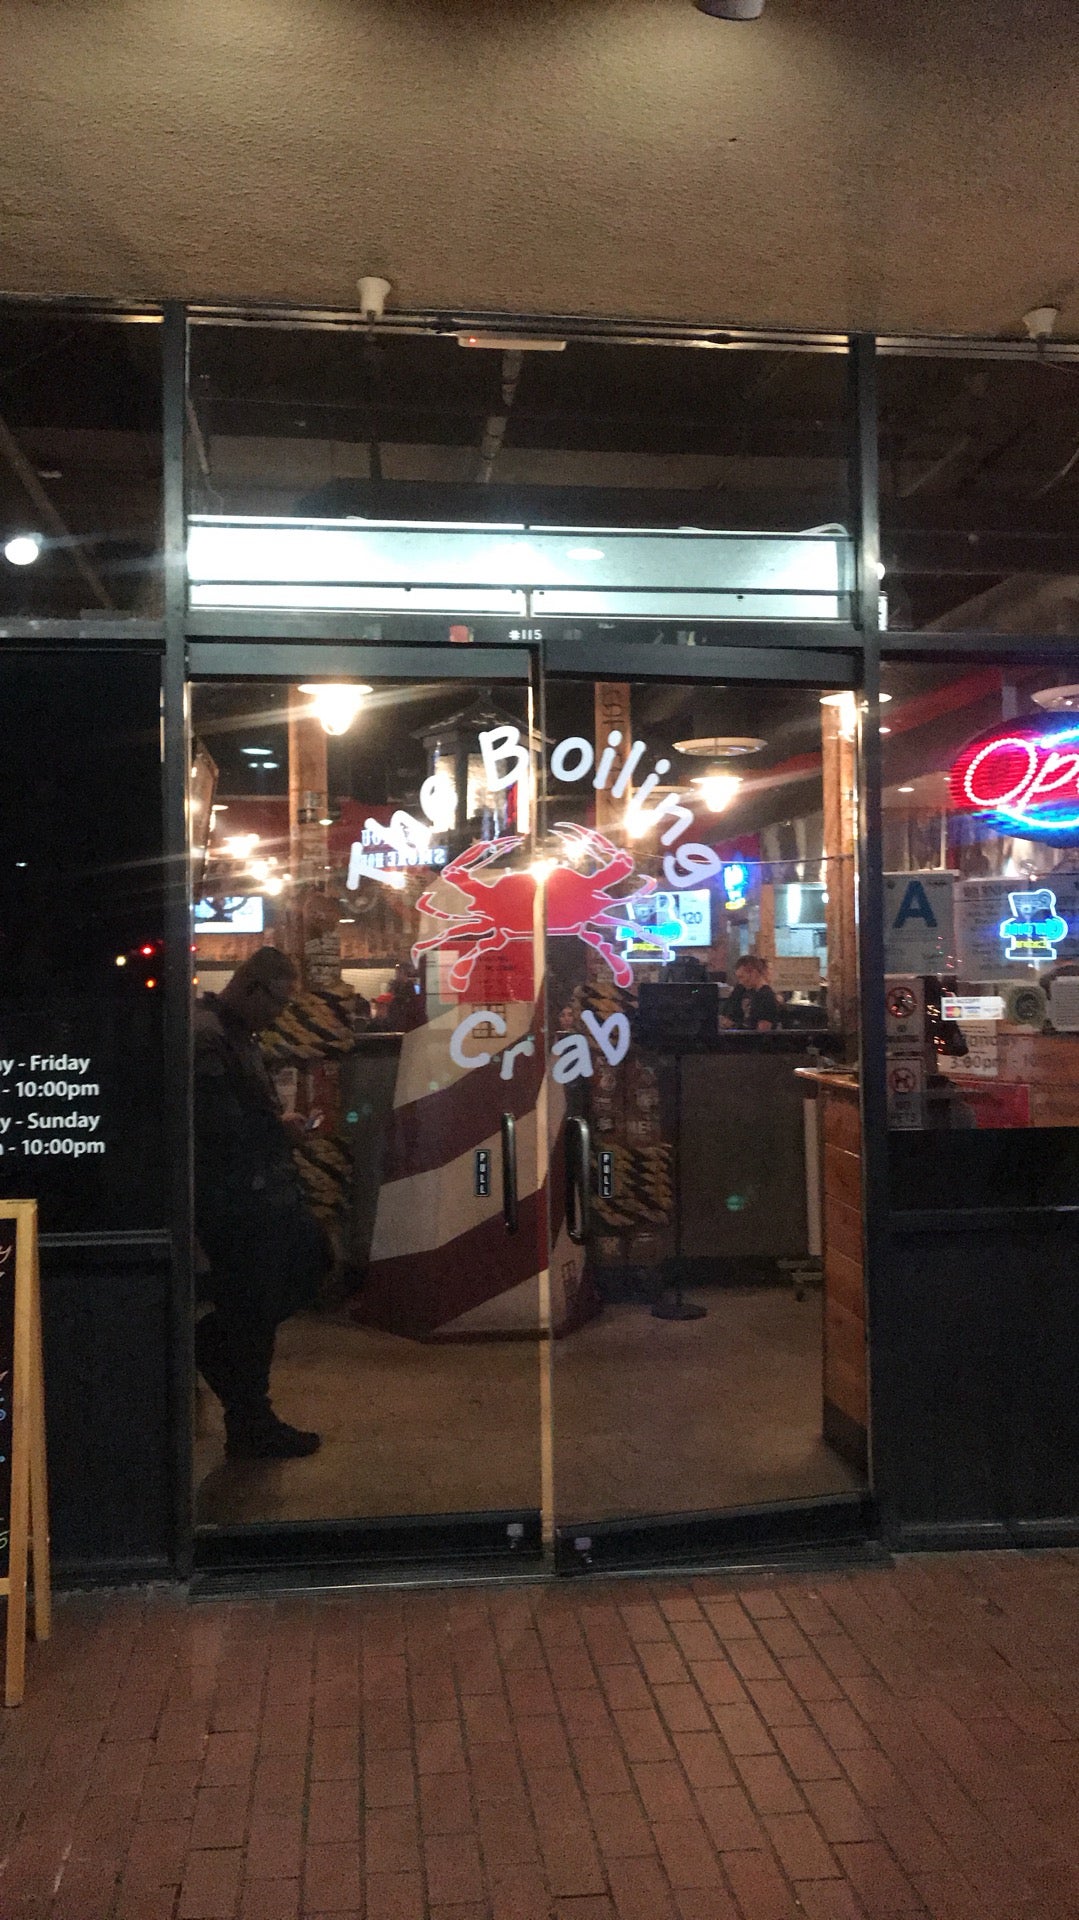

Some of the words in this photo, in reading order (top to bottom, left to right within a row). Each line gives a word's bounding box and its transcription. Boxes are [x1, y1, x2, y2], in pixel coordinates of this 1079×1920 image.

[508, 629, 543, 640] #115
[964, 738, 1079, 812] Op
[478, 725, 723, 888] Boiling
[893, 881, 938, 928] A
[450, 1010, 631, 1084] Crab
[30, 1054, 91, 1075] Friday
[15, 1081, 100, 1100] 10:00pm
[27, 1111, 101, 1132] Sunday
[21, 1138, 105, 1158] 10:00pm
